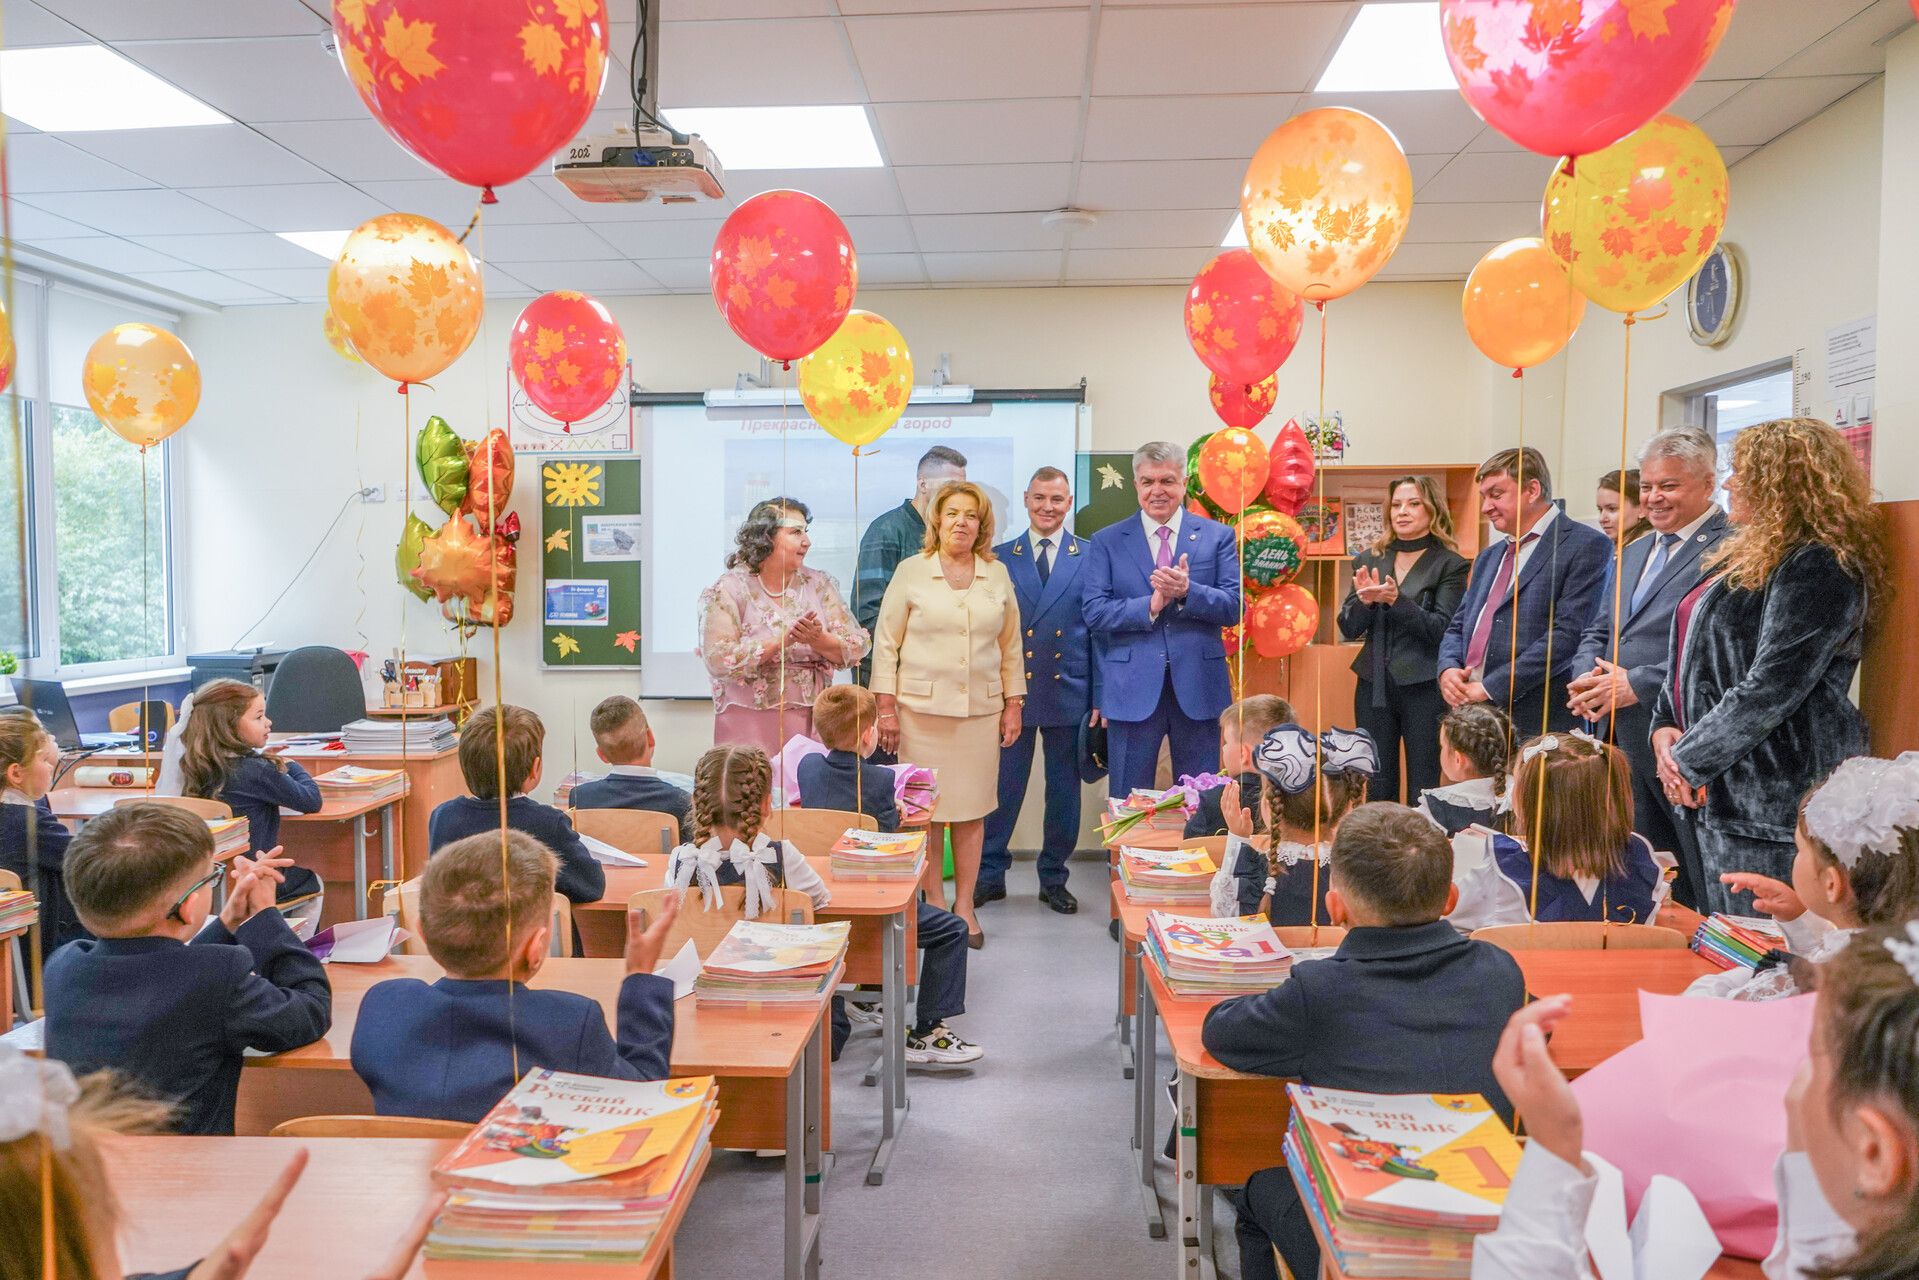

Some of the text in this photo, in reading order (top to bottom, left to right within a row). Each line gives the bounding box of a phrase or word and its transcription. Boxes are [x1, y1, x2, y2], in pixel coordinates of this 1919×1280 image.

[570, 146, 591, 159] 202
[903, 417, 952, 433] город
[1257, 548, 1288, 560] ДЕНЬ
[527, 1083, 625, 1105] Русский
[1310, 1100, 1415, 1120] Русский
[593, 1127, 654, 1166] 1
[1450, 1146, 1512, 1189] 1
